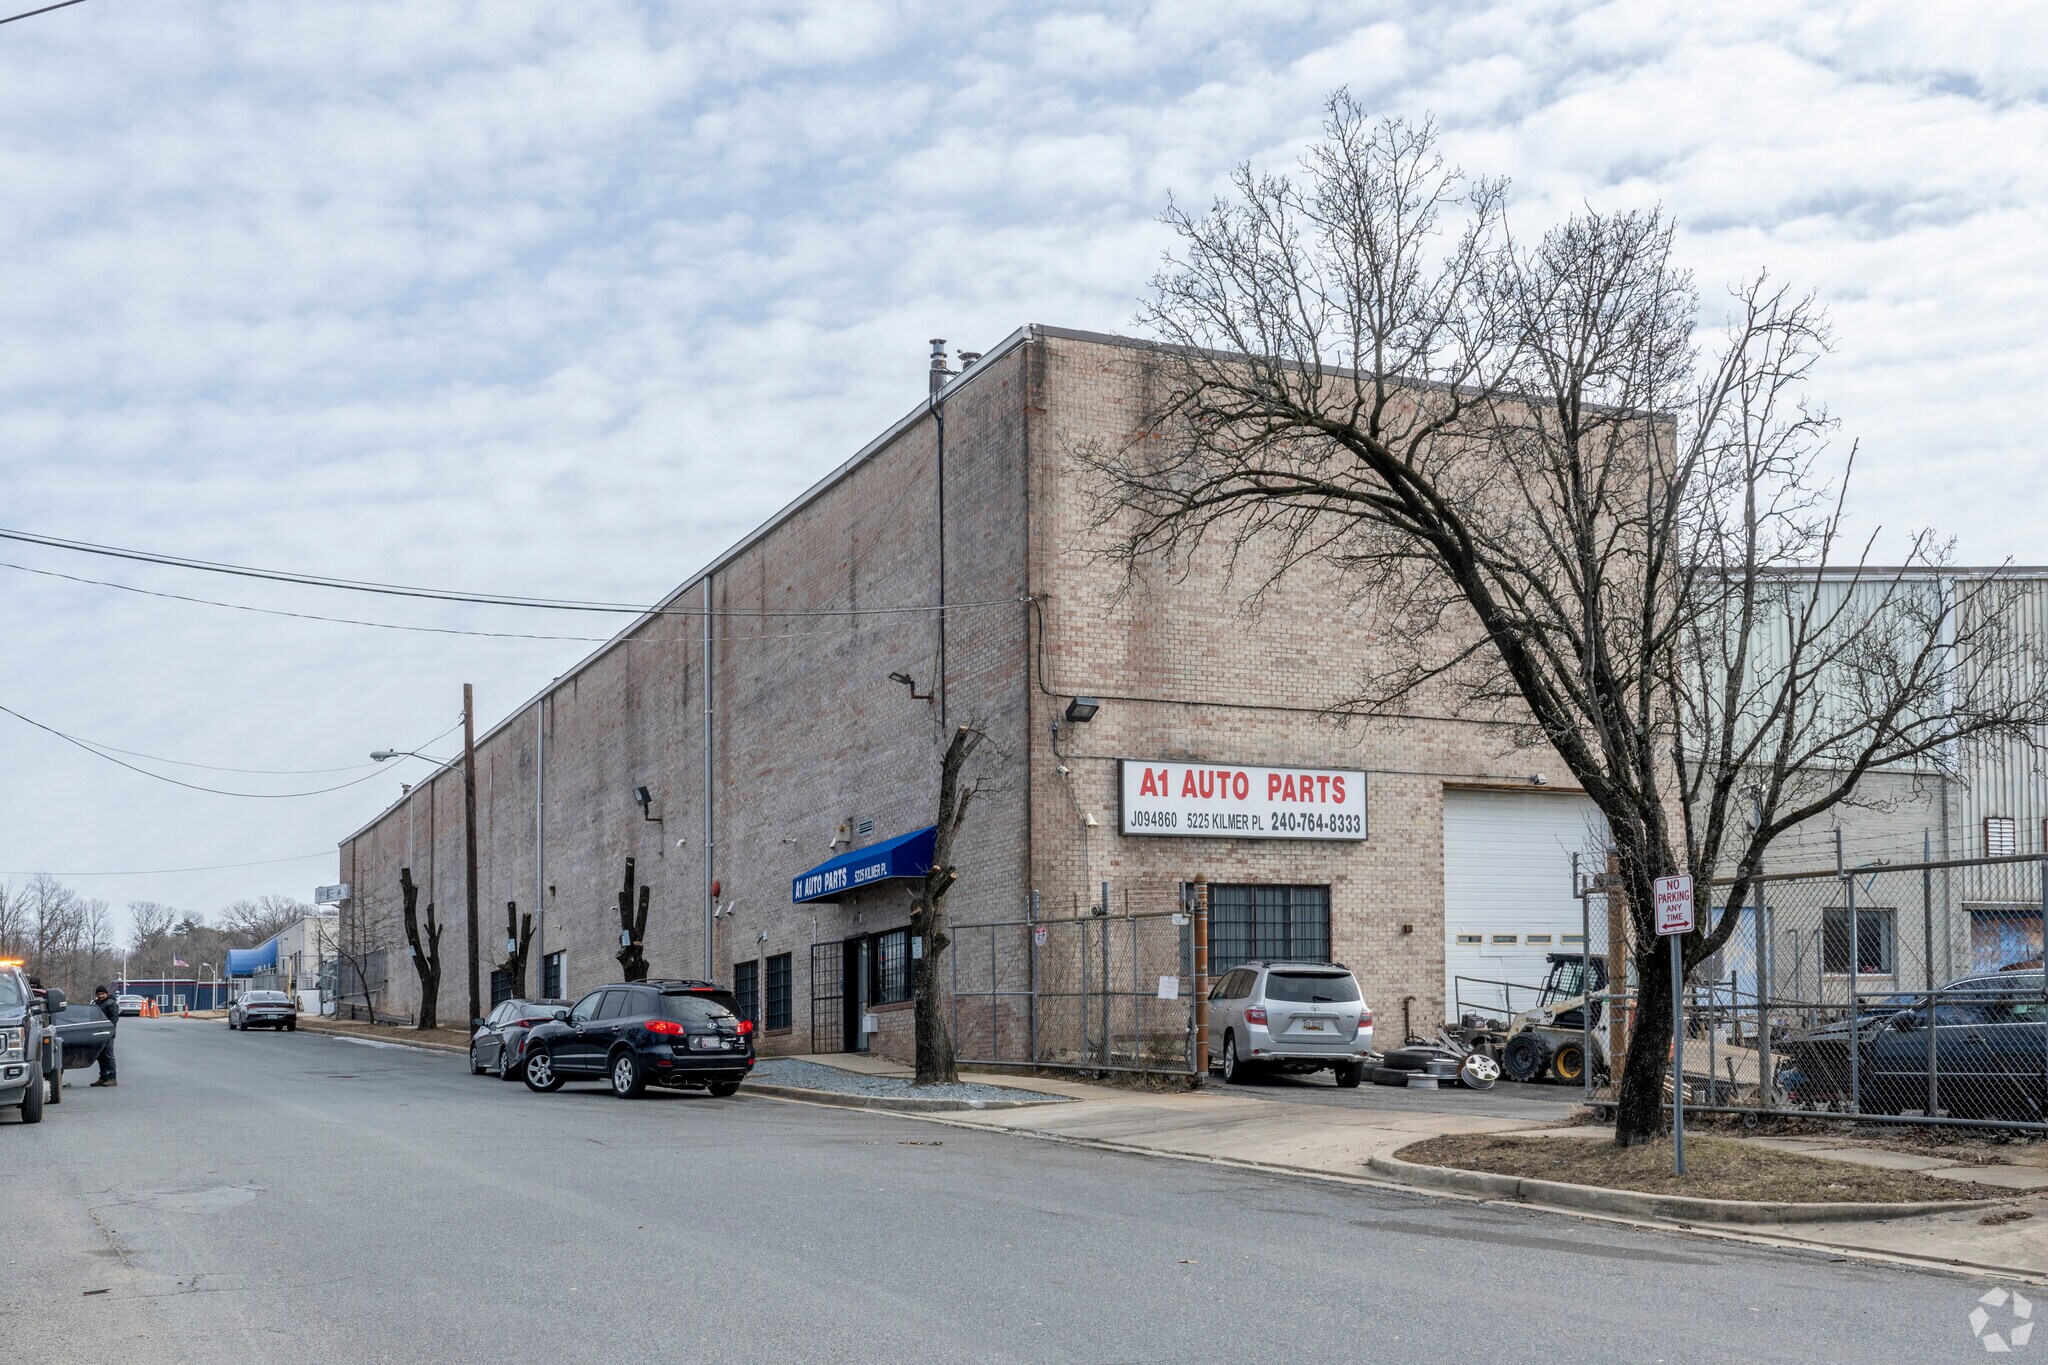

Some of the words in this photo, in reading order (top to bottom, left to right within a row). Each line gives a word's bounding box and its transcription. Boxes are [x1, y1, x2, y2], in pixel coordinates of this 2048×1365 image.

[1139, 767, 1169, 797] A1
[1181, 769, 1250, 801] AUTO
[1267, 773, 1346, 804] PARTS
[1130, 810, 1178, 828] J094860
[1187, 812, 1210, 829] 5225
[1212, 813, 1249, 831] KILMER
[1252, 815, 1264, 831] PL
[795, 881, 802, 898] A1
[804, 877, 822, 896] AUTO
[824, 867, 847, 891] PARTS
[854, 871, 864, 882] 5225
[865, 864, 880, 880] KILMER
[880, 862, 887, 875] PL
[1666, 879, 1680, 890] NO
[1658, 890, 1689, 904] PARKING
[1666, 904, 1682, 912] ANY
[1666, 913, 1683, 921] TIME
